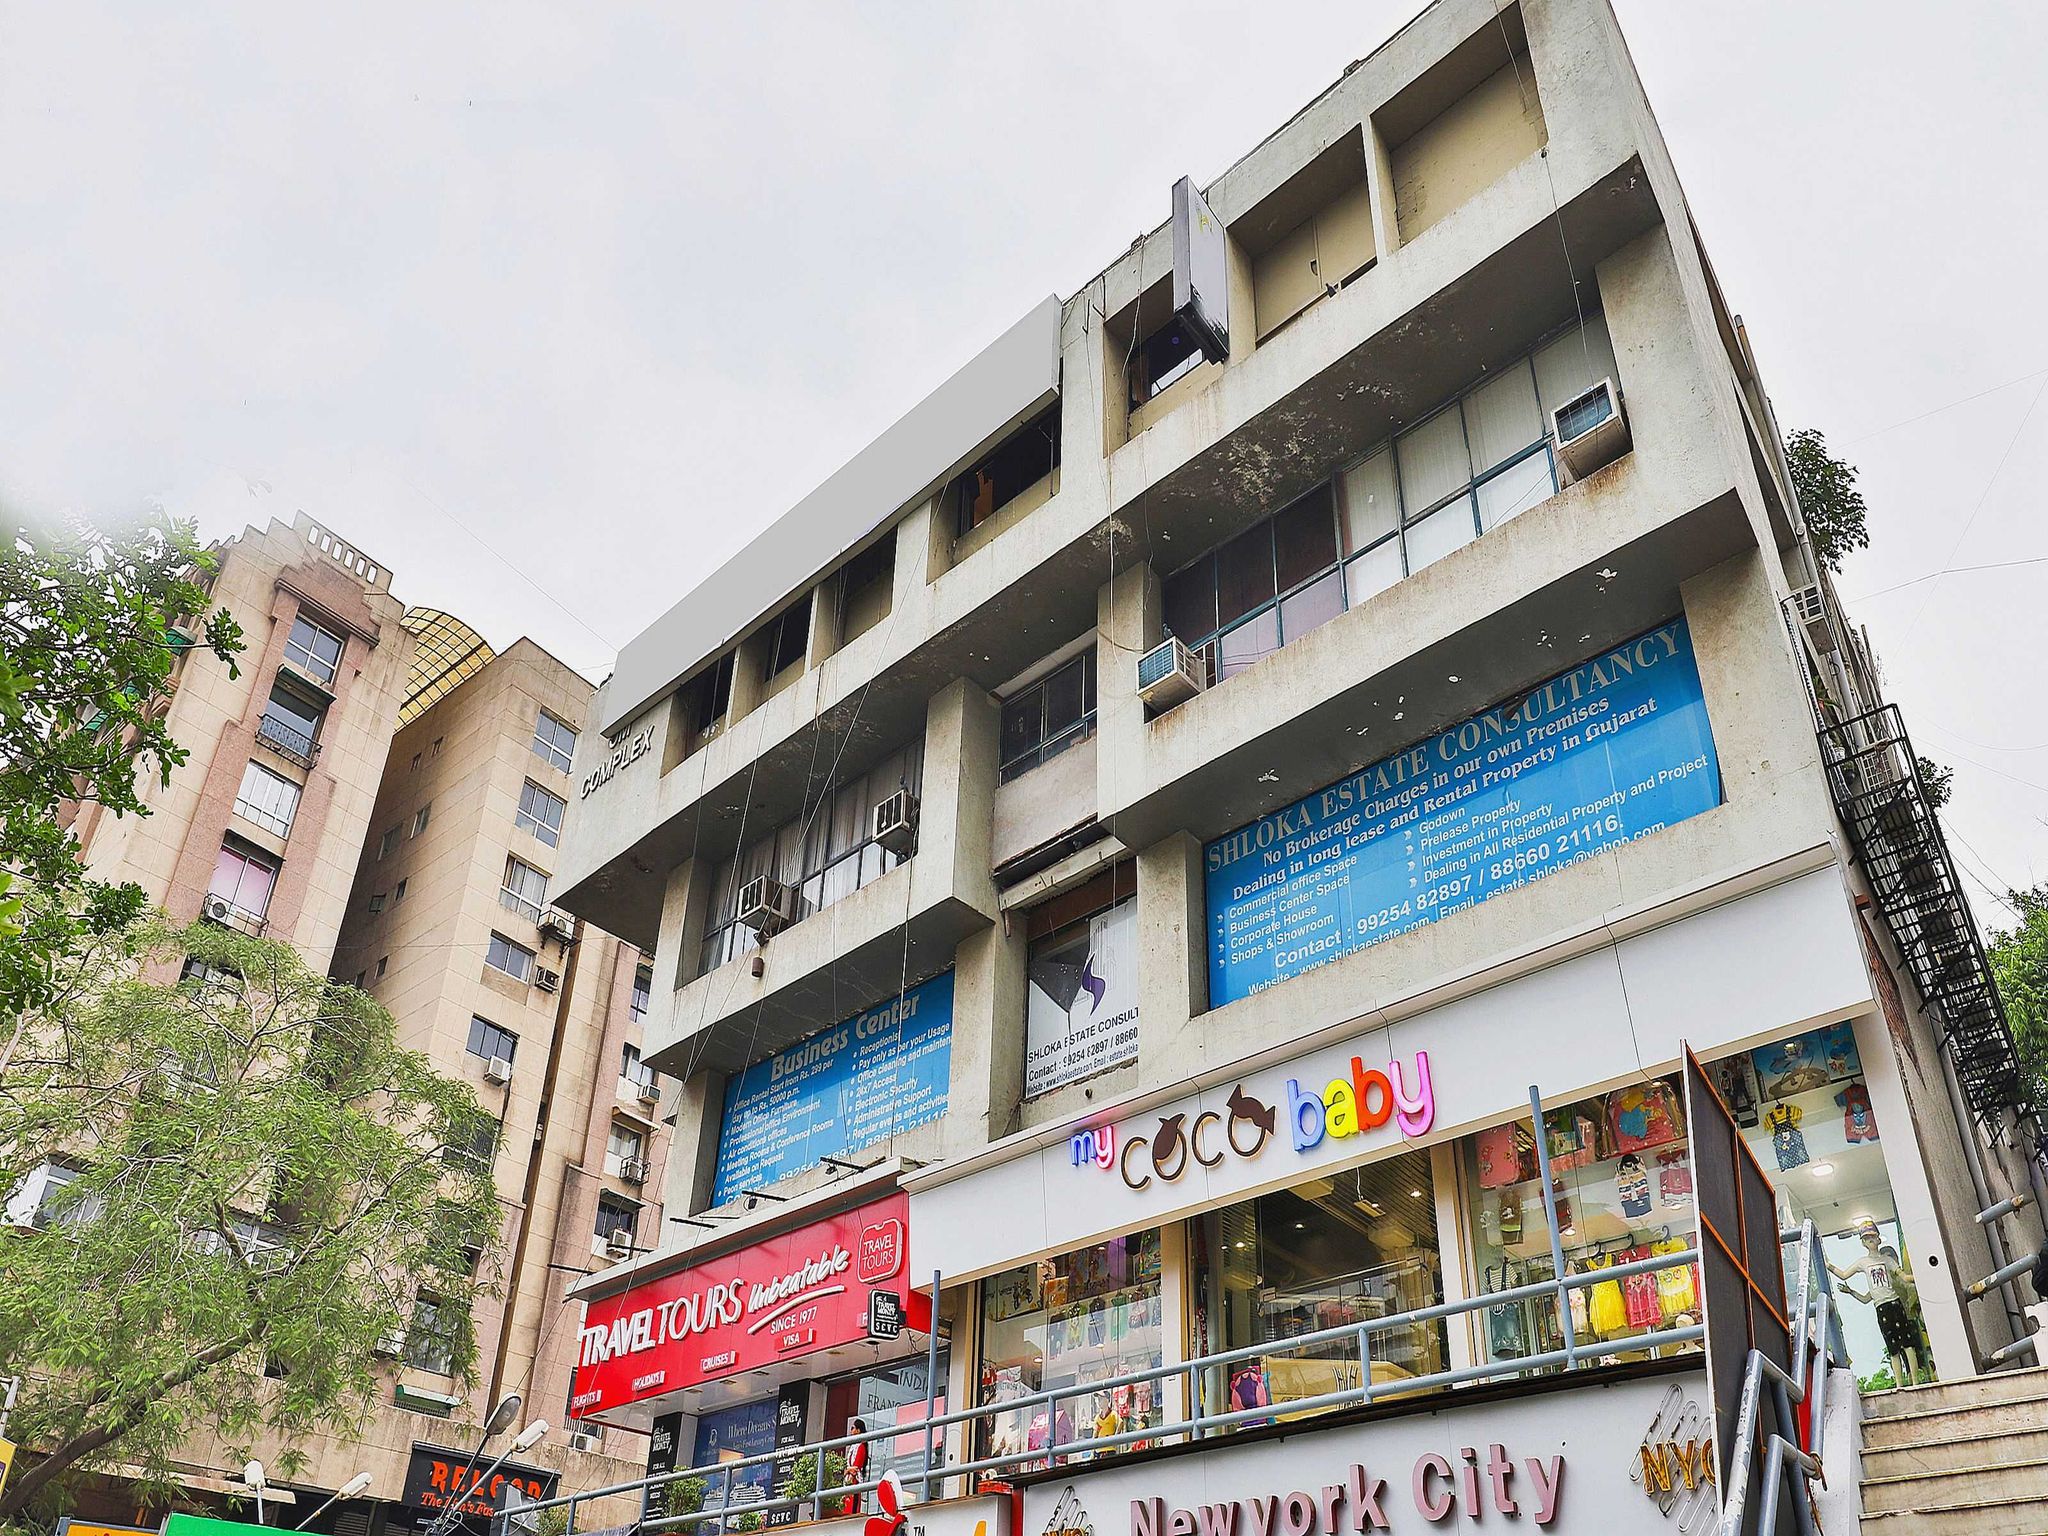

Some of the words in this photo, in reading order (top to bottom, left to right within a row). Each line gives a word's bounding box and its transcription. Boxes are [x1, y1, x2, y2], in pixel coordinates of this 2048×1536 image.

[580, 724, 655, 800] COMPLEX
[1264, 850, 1281, 868] No
[1286, 813, 1361, 857] Brokerage
[1364, 781, 1429, 819] Charges
[1433, 771, 1449, 789] in
[1453, 752, 1482, 779] our
[1487, 739, 1522, 763] own
[1526, 698, 1610, 745] Premises
[1208, 803, 1313, 873] SHLOKA
[1321, 746, 1429, 820] ESTATE
[1233, 867, 1286, 900] Dealing
[1290, 860, 1304, 875] in
[1307, 844, 1341, 866] long
[1346, 824, 1385, 850] lease
[1391, 806, 1419, 829] and
[1425, 780, 1477, 814] Rental
[1482, 743, 1557, 788] Property
[1562, 735, 1581, 751] in
[1585, 697, 1658, 741] Gujarat
[1418, 805, 1466, 834] Godown
[1424, 858, 1468, 884] Dealing
[1470, 849, 1480, 863] in
[1483, 837, 1499, 856] All
[1502, 812, 1569, 851] Residential
[1571, 790, 1626, 824] Property
[1630, 776, 1655, 797] and
[1658, 752, 1708, 785] Project
[1420, 824, 1469, 851] Prelease
[1471, 800, 1521, 834] Property
[1422, 833, 1486, 867] Investment
[1488, 827, 1499, 839] in
[1501, 802, 1553, 838] Property
[1229, 884, 1289, 919] Commercial
[1291, 872, 1321, 892] office
[1324, 855, 1357, 881] Space
[1230, 908, 1276, 934] Business
[1279, 891, 1313, 912] Center
[1316, 873, 1350, 898] Space
[1274, 929, 1342, 968] Contact
[1356, 899, 1412, 936] 99254
[1416, 874, 1472, 911] 82897
[1490, 843, 1551, 881] 88660
[1230, 921, 1281, 949] Corporate
[1283, 904, 1318, 925] House
[1440, 900, 1475, 919] Email
[1231, 945, 1264, 965] Shops
[1266, 938, 1275, 950] &
[1276, 914, 1334, 946] Showroom
[771, 1029, 849, 1082] Business
[856, 994, 920, 1039] Center
[858, 1058, 871, 1072] Pay
[871, 1051, 886, 1066] only
[887, 1048, 896, 1057] as
[897, 1040, 909, 1055] per
[909, 1032, 927, 1049] your
[927, 1022, 950, 1038] Usage
[1028, 1040, 1062, 1064] SHLOKA
[1064, 1024, 1096, 1047] ESTATE
[1028, 1063, 1057, 1082] Contact
[1115, 1027, 1138, 1046] 88660
[857, 1068, 877, 1084] Office
[878, 1056, 907, 1076] cleaning
[907, 1048, 921, 1062] and
[872, 1074, 897, 1089] Access
[1094, 1055, 1106, 1069] Email
[734, 1097, 750, 1112] Office
[751, 1087, 770, 1102] Rental
[770, 1081, 785, 1094] Start
[784, 1075, 799, 1089] from
[800, 1070, 810, 1081] Rs.
[822, 1058, 834, 1074] per
[853, 1100, 901, 1127] Administrative
[903, 1083, 932, 1104] Support
[854, 1091, 888, 1112] Electronic
[889, 1076, 918, 1097] Security
[729, 1125, 764, 1148] Professional
[764, 1116, 782, 1130] office
[782, 1099, 821, 1126] Environment
[731, 1118, 753, 1136] Modern
[752, 1112, 769, 1126] Office
[770, 1099, 798, 1119] Furniture
[732, 1111, 743, 1124] day
[852, 1122, 879, 1141] Regular
[879, 1113, 902, 1128] events
[903, 1105, 917, 1119] and
[1070, 1124, 1115, 1170] my
[1286, 1050, 1437, 1154] baby
[726, 1154, 749, 1172] Meeting
[750, 1146, 770, 1160] Rooms
[776, 1128, 811, 1149] Conference
[811, 1118, 834, 1135] Rooms
[727, 1149, 737, 1160] Air
[768, 1126, 788, 1141] offices
[722, 1182, 739, 1197] Peon
[738, 1172, 763, 1190] services
[724, 1164, 750, 1184] Available
[750, 1161, 760, 1171] on
[759, 1150, 785, 1169] Request
[862, 1234, 894, 1256] TRAVEL
[862, 1250, 894, 1272] TOURS
[582, 1308, 656, 1368] TRAVEL
[656, 1277, 746, 1345] TOURS
[748, 1243, 850, 1313] Unbeatable
[770, 1315, 797, 1335] SINCE
[799, 1306, 818, 1326] 1977
[702, 1354, 729, 1371] CRUISES
[783, 1333, 801, 1348] VISA
[634, 1371, 661, 1390] HOLIDAYS
[900, 1368, 928, 1394] INDI
[421, 1492, 443, 1507] The
[1412, 1443, 1567, 1528] City
